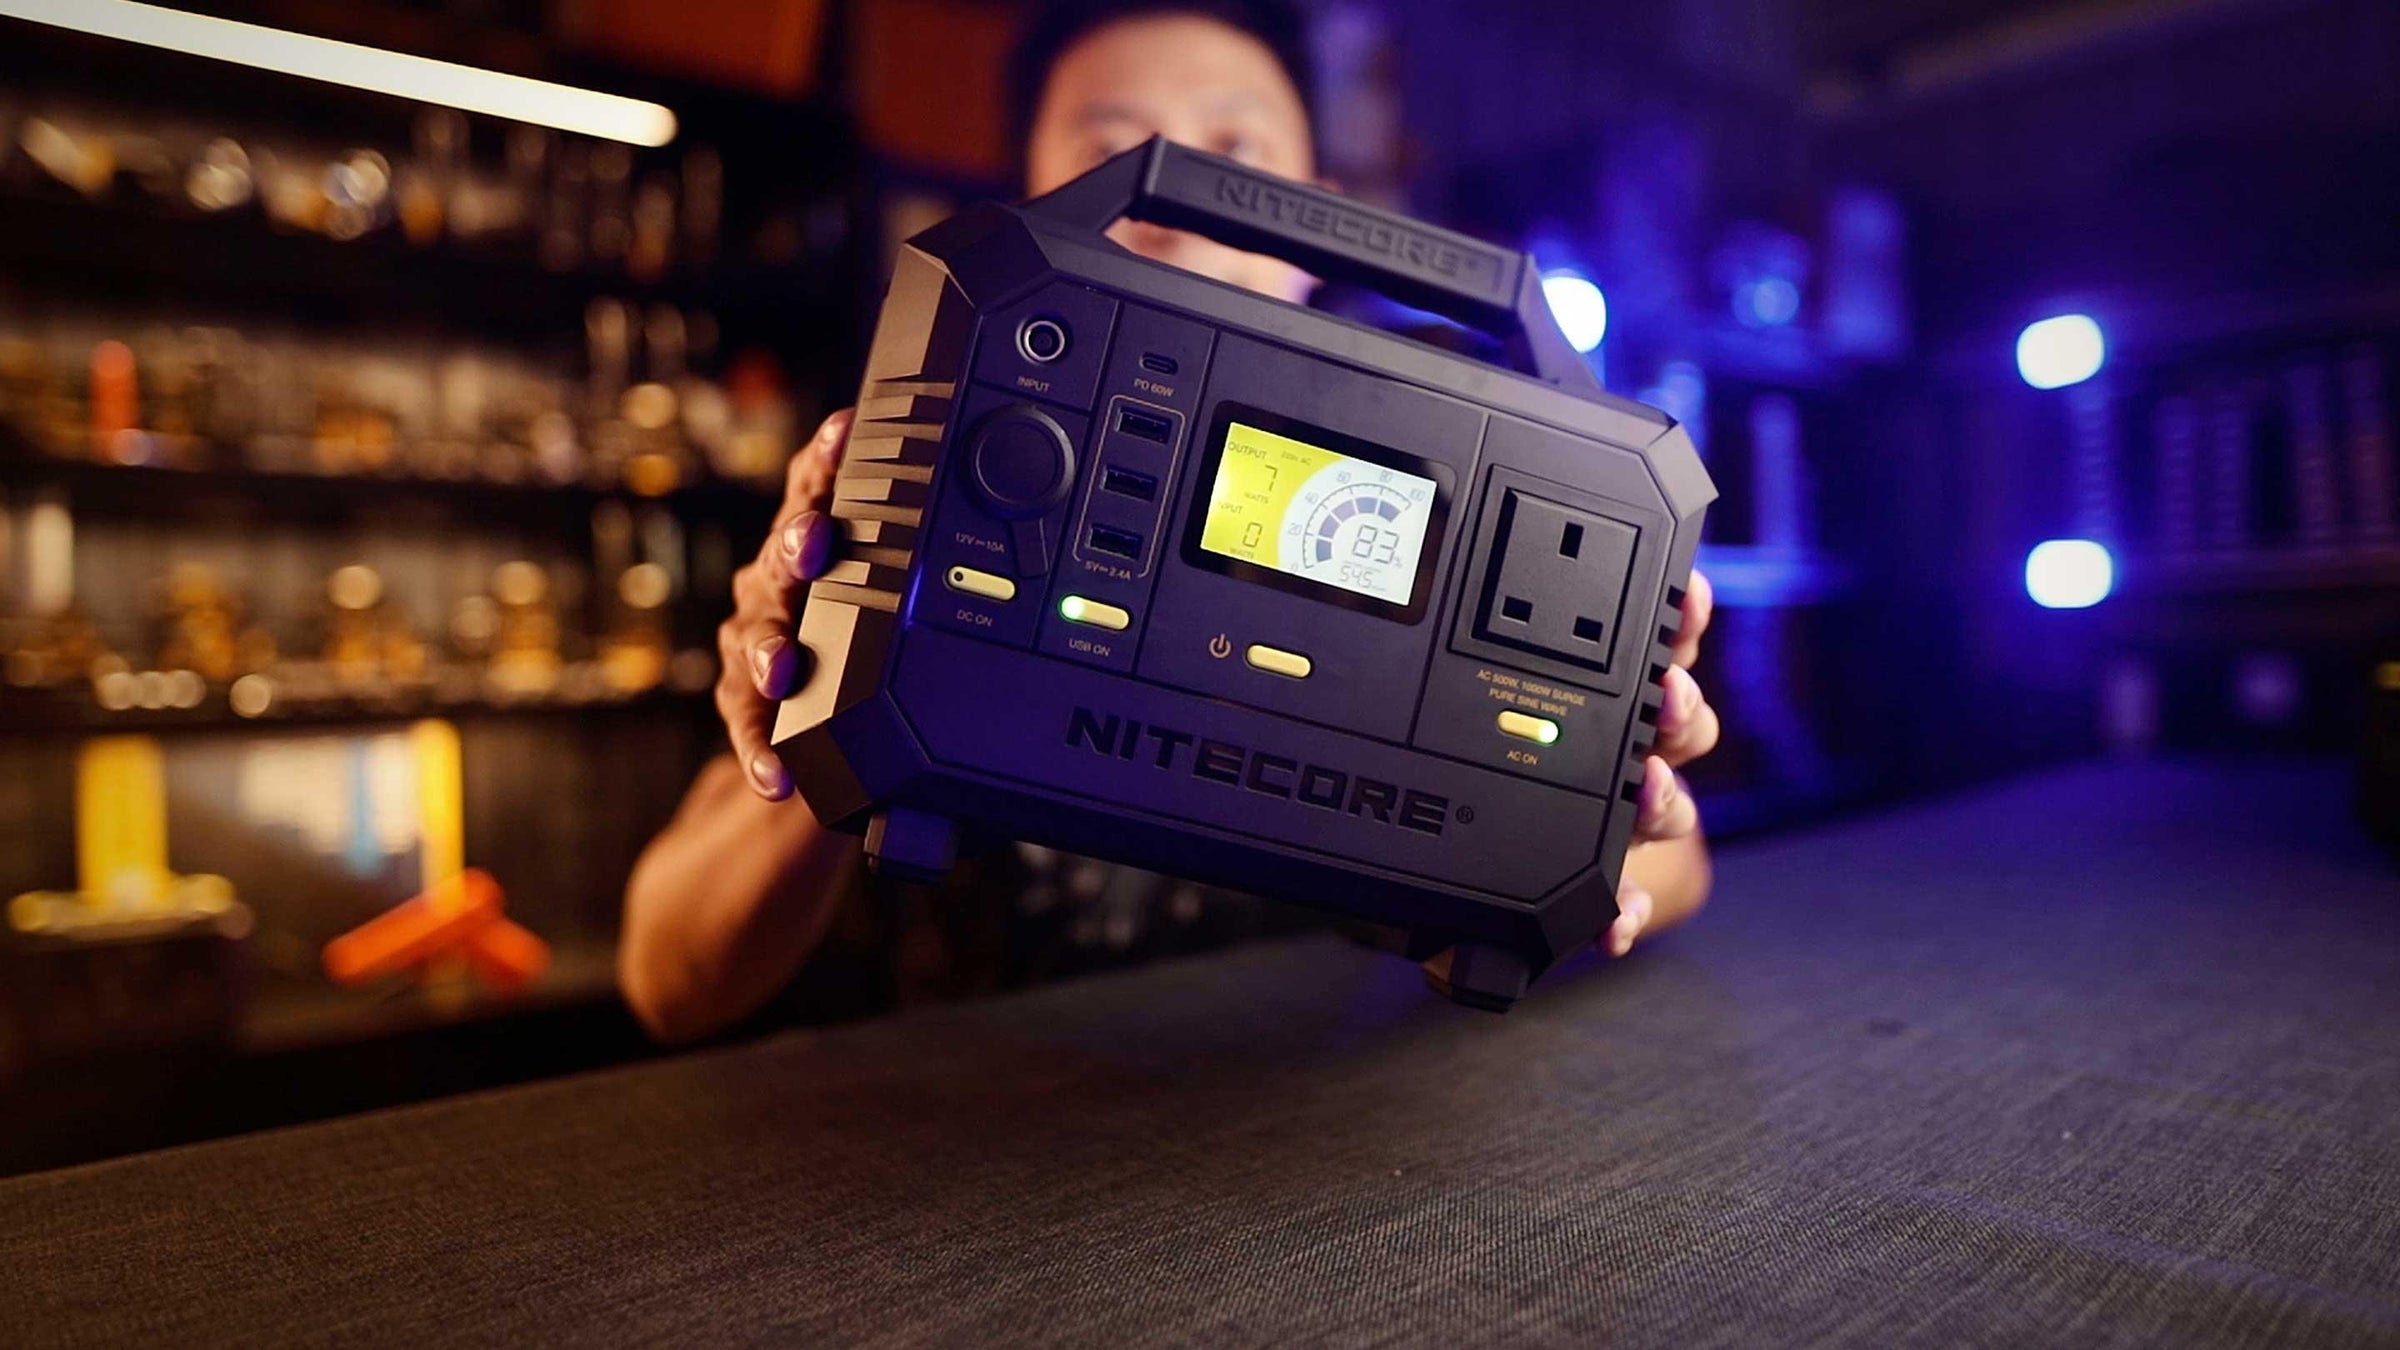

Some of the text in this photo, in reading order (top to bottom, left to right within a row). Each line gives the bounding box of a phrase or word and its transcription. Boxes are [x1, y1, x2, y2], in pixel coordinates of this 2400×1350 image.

[1017, 376, 1051, 393] INPUT
[1134, 378, 1174, 397] PD 60W
[1227, 441, 1268, 460] OUTPUT
[1264, 464, 1278, 492] 7
[1218, 502, 1244, 515] PUT
[1242, 521, 1263, 548] 0
[956, 609, 993, 627] DC ON
[1068, 638, 1111, 657] USB ON
[1477, 669, 1492, 681] AC
[1552, 688, 1586, 706] SURGE
[1488, 687, 1568, 717] PURE SINE WAVE
[1506, 750, 1539, 765] AC ON
